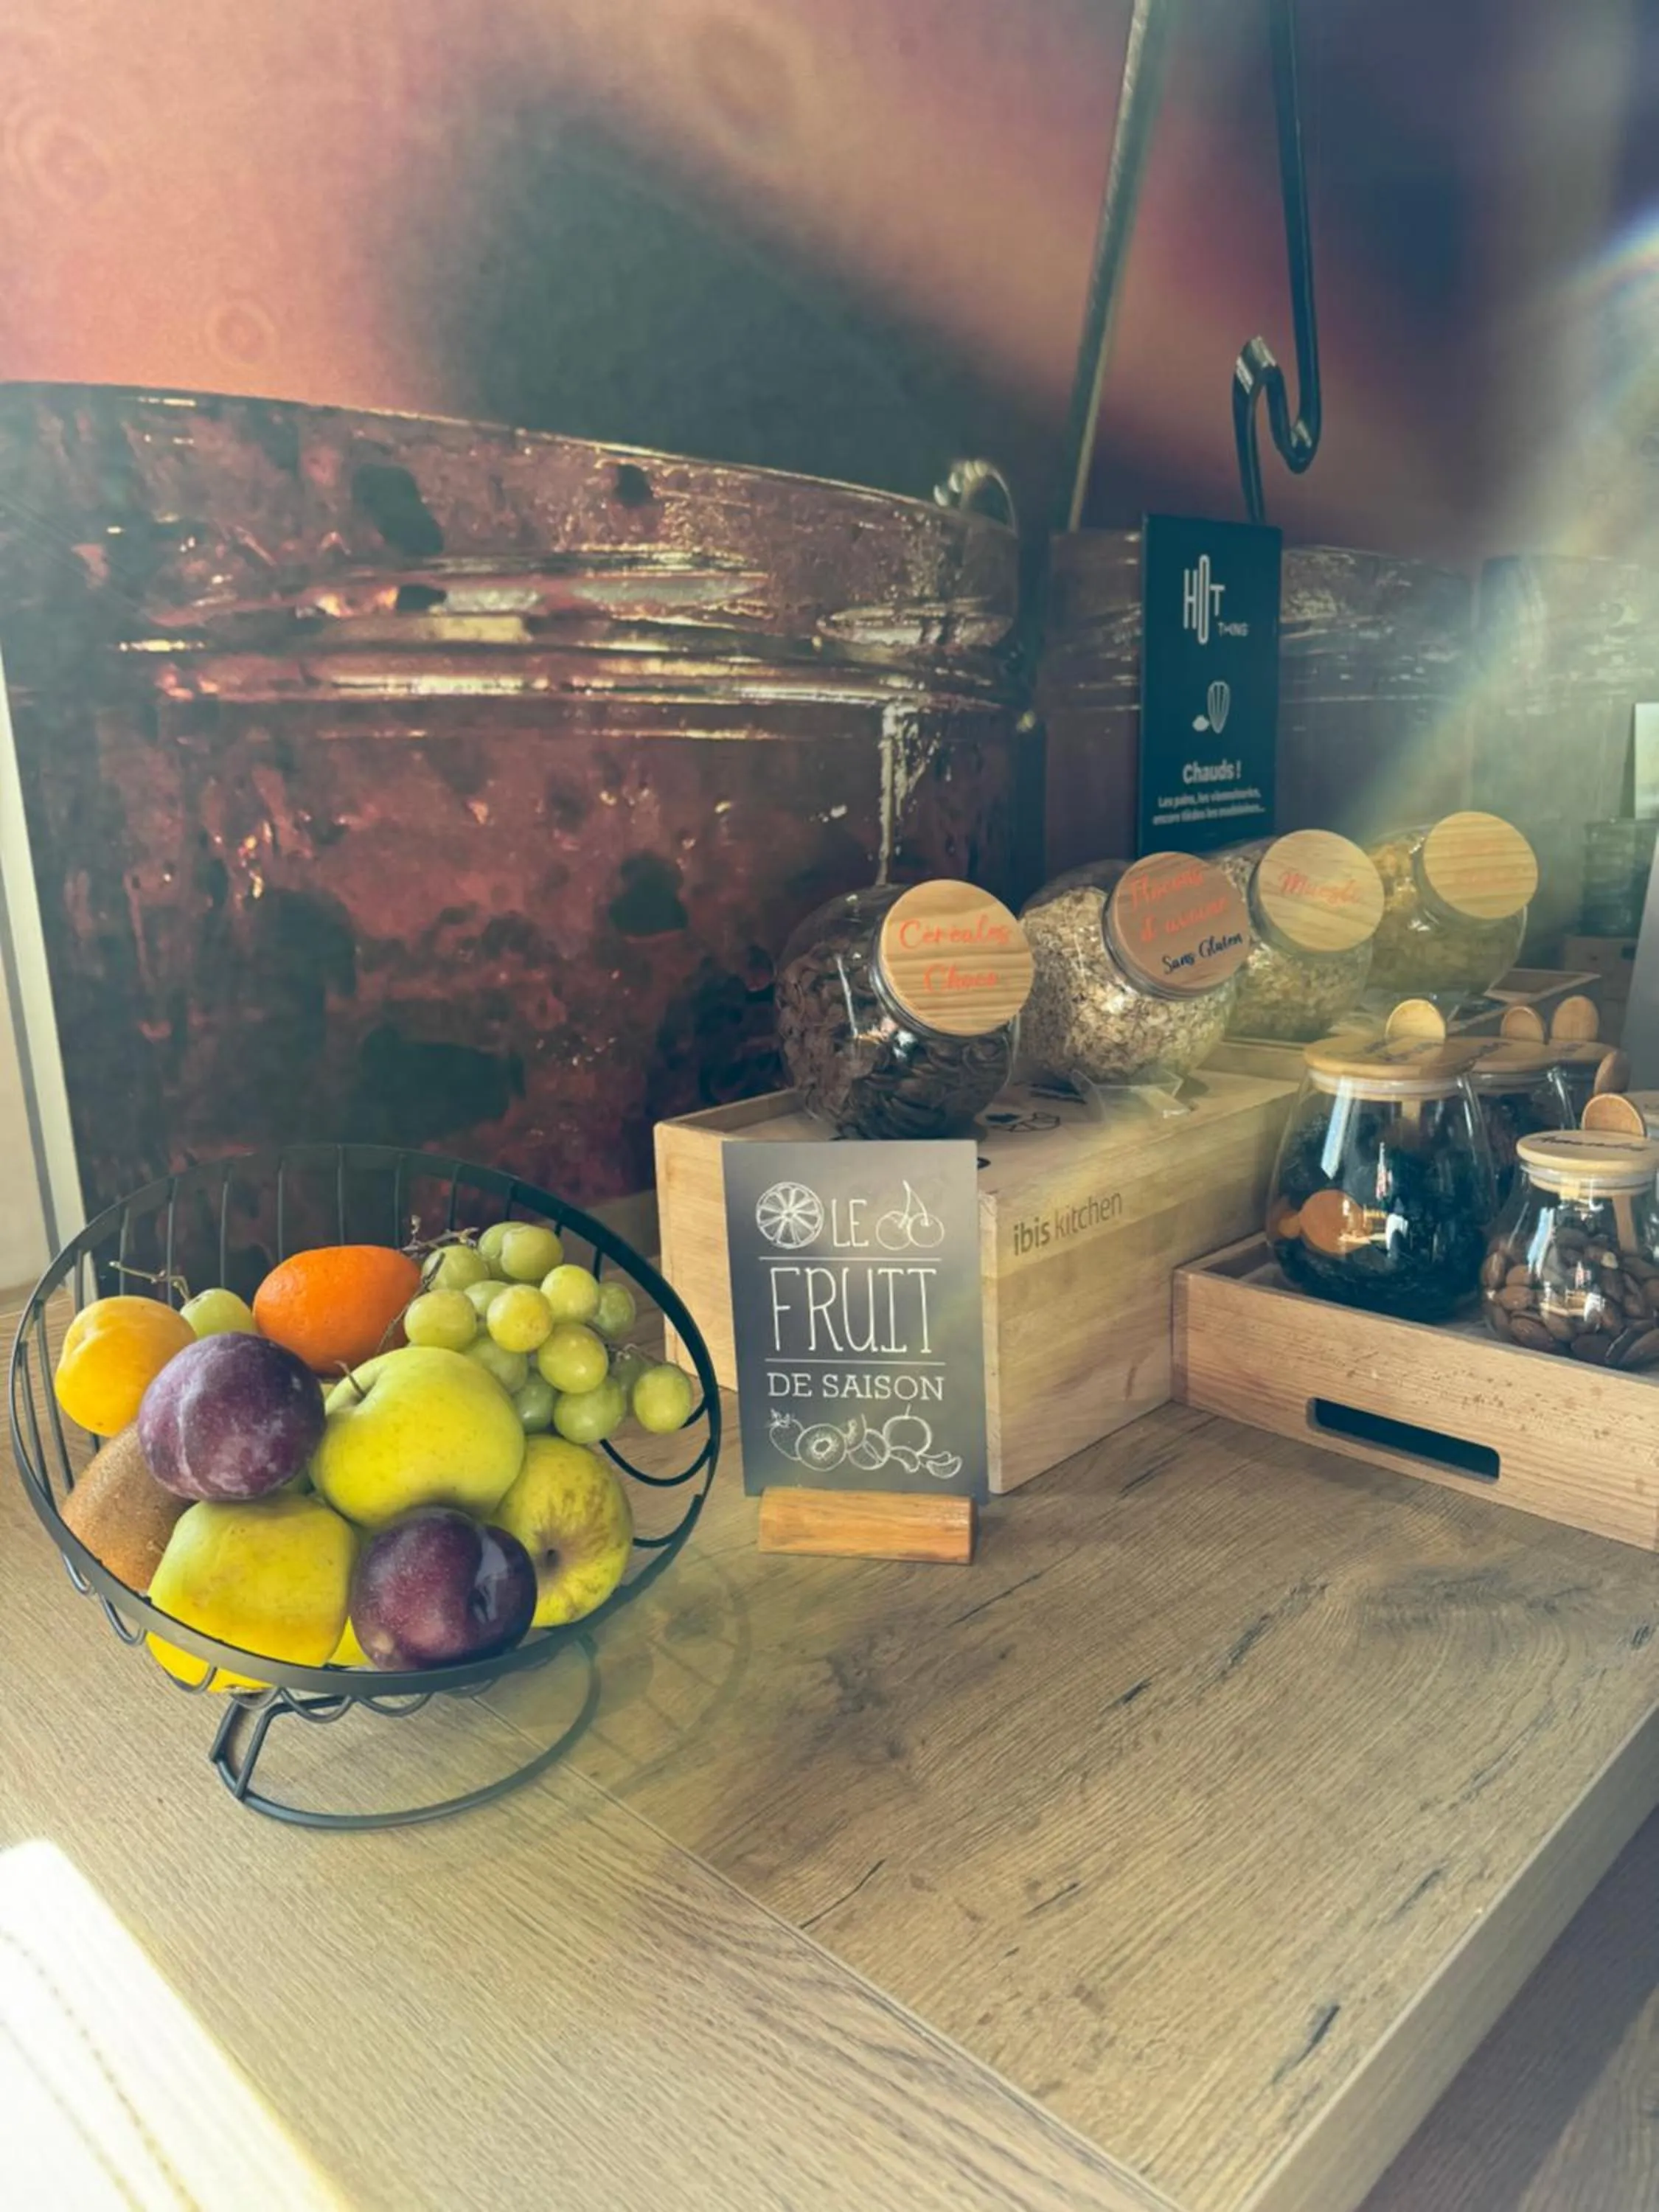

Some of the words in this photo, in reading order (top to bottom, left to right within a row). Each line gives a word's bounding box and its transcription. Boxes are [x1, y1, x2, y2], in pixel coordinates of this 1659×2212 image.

[1183, 554, 1225, 644] HOT
[1161, 953, 1195, 975] Sans
[1199, 933, 1243, 958] Gluten
[831, 1198, 869, 1248] LE
[1013, 1217, 1050, 1256] ibis
[1054, 1192, 1123, 1240] kitchen
[770, 1266, 937, 1354] FRUIT
[767, 1371, 812, 1398] DE
[821, 1374, 945, 1401] SAISON
